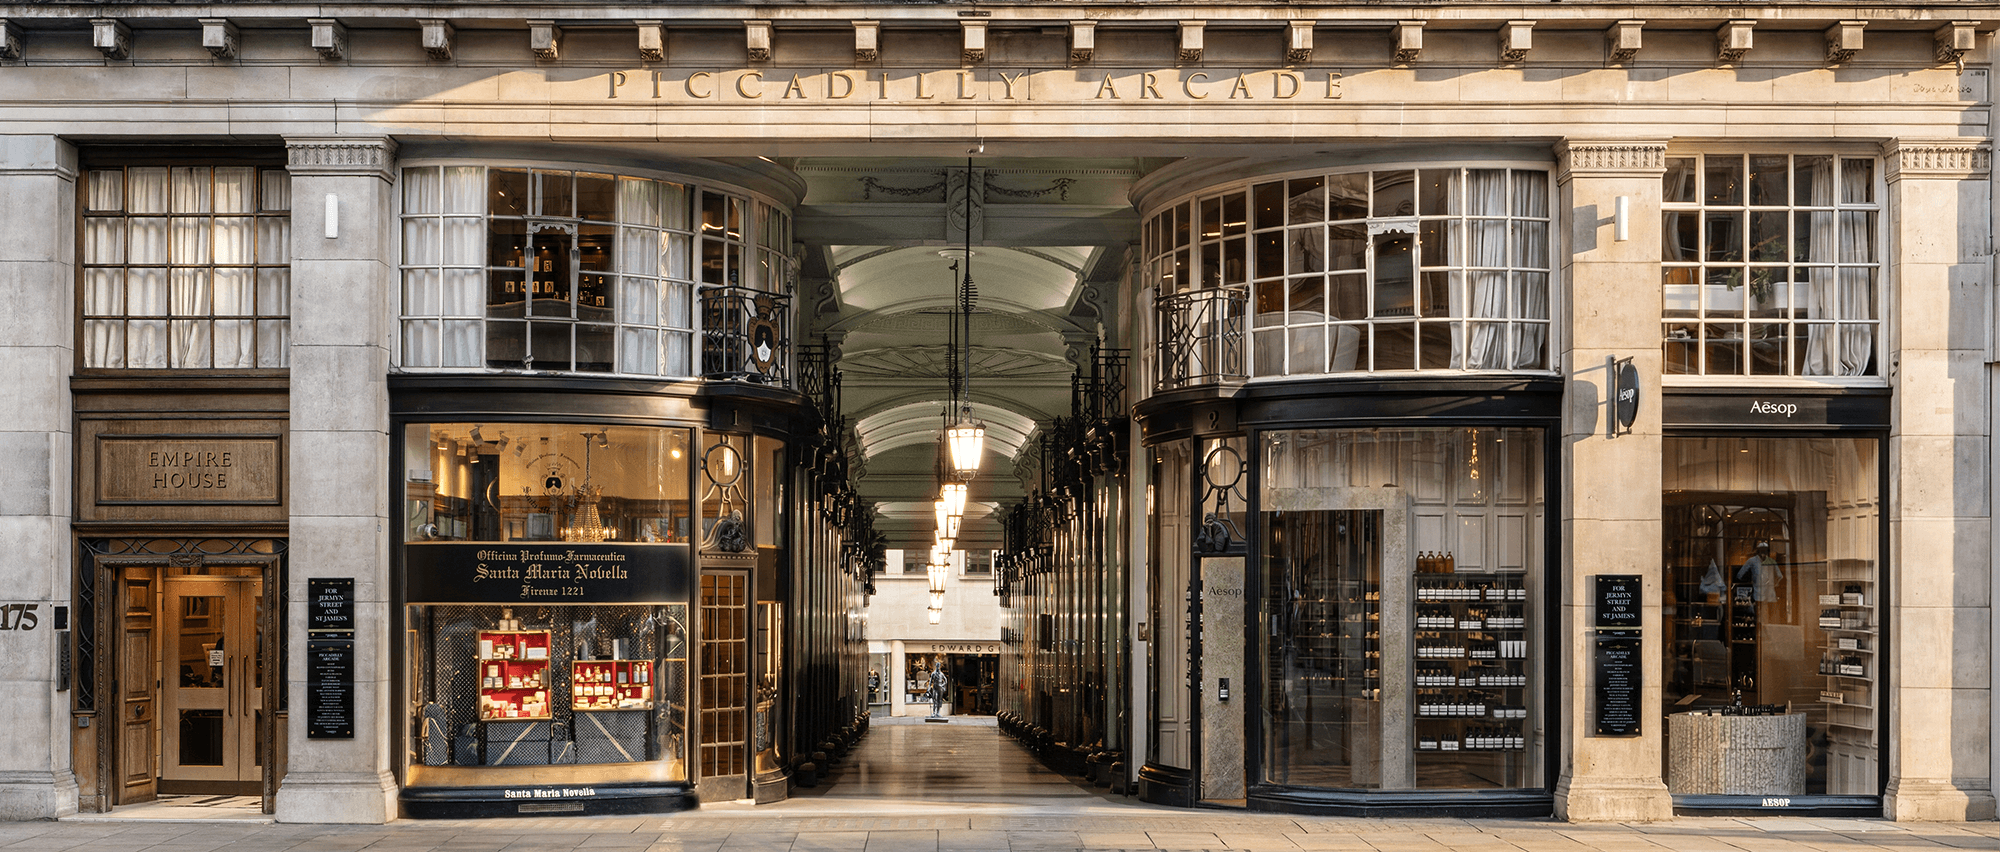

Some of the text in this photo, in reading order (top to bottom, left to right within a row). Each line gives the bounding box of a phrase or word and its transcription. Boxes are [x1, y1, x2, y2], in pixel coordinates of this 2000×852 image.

[606, 71, 1345, 101] PICCADILLY ARCADE
[1749, 399, 1797, 418] Aēsop
[148, 451, 232, 468] EMPIRE
[152, 472, 227, 489] HOUSE
[476, 549, 517, 562] Officina
[473, 563, 628, 584] Santa Maria Novella
[520, 584, 585, 599] Firenze 1221
[0, 604, 39, 631] 175
[931, 644, 982, 652] EDWARD
[504, 787, 596, 798] Santa Maria Novella
[1762, 797, 1791, 807] AESOP
